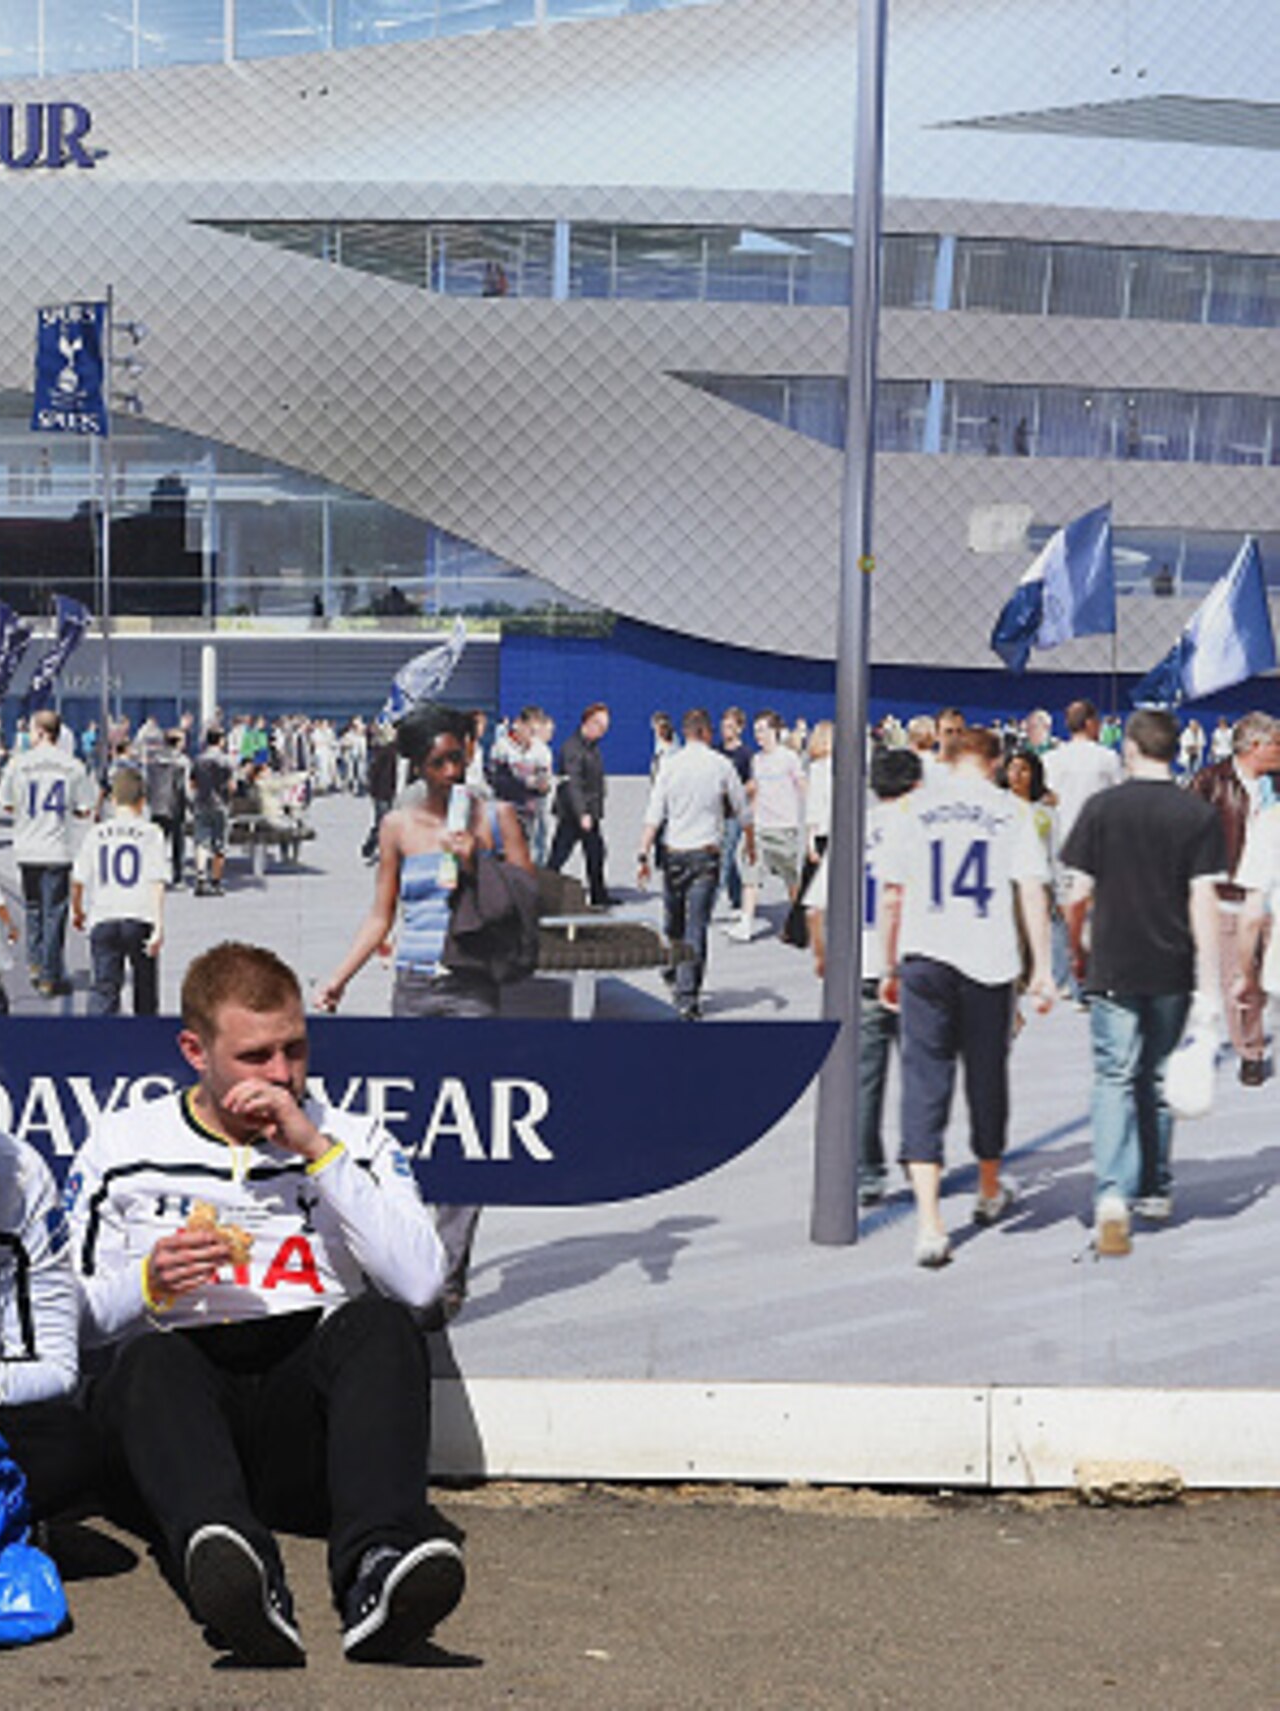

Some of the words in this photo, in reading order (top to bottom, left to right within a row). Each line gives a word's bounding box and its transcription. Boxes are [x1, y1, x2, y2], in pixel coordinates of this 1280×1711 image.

[28, 780, 67, 821] 14
[98, 844, 141, 887] 10
[928, 840, 996, 918] 14
